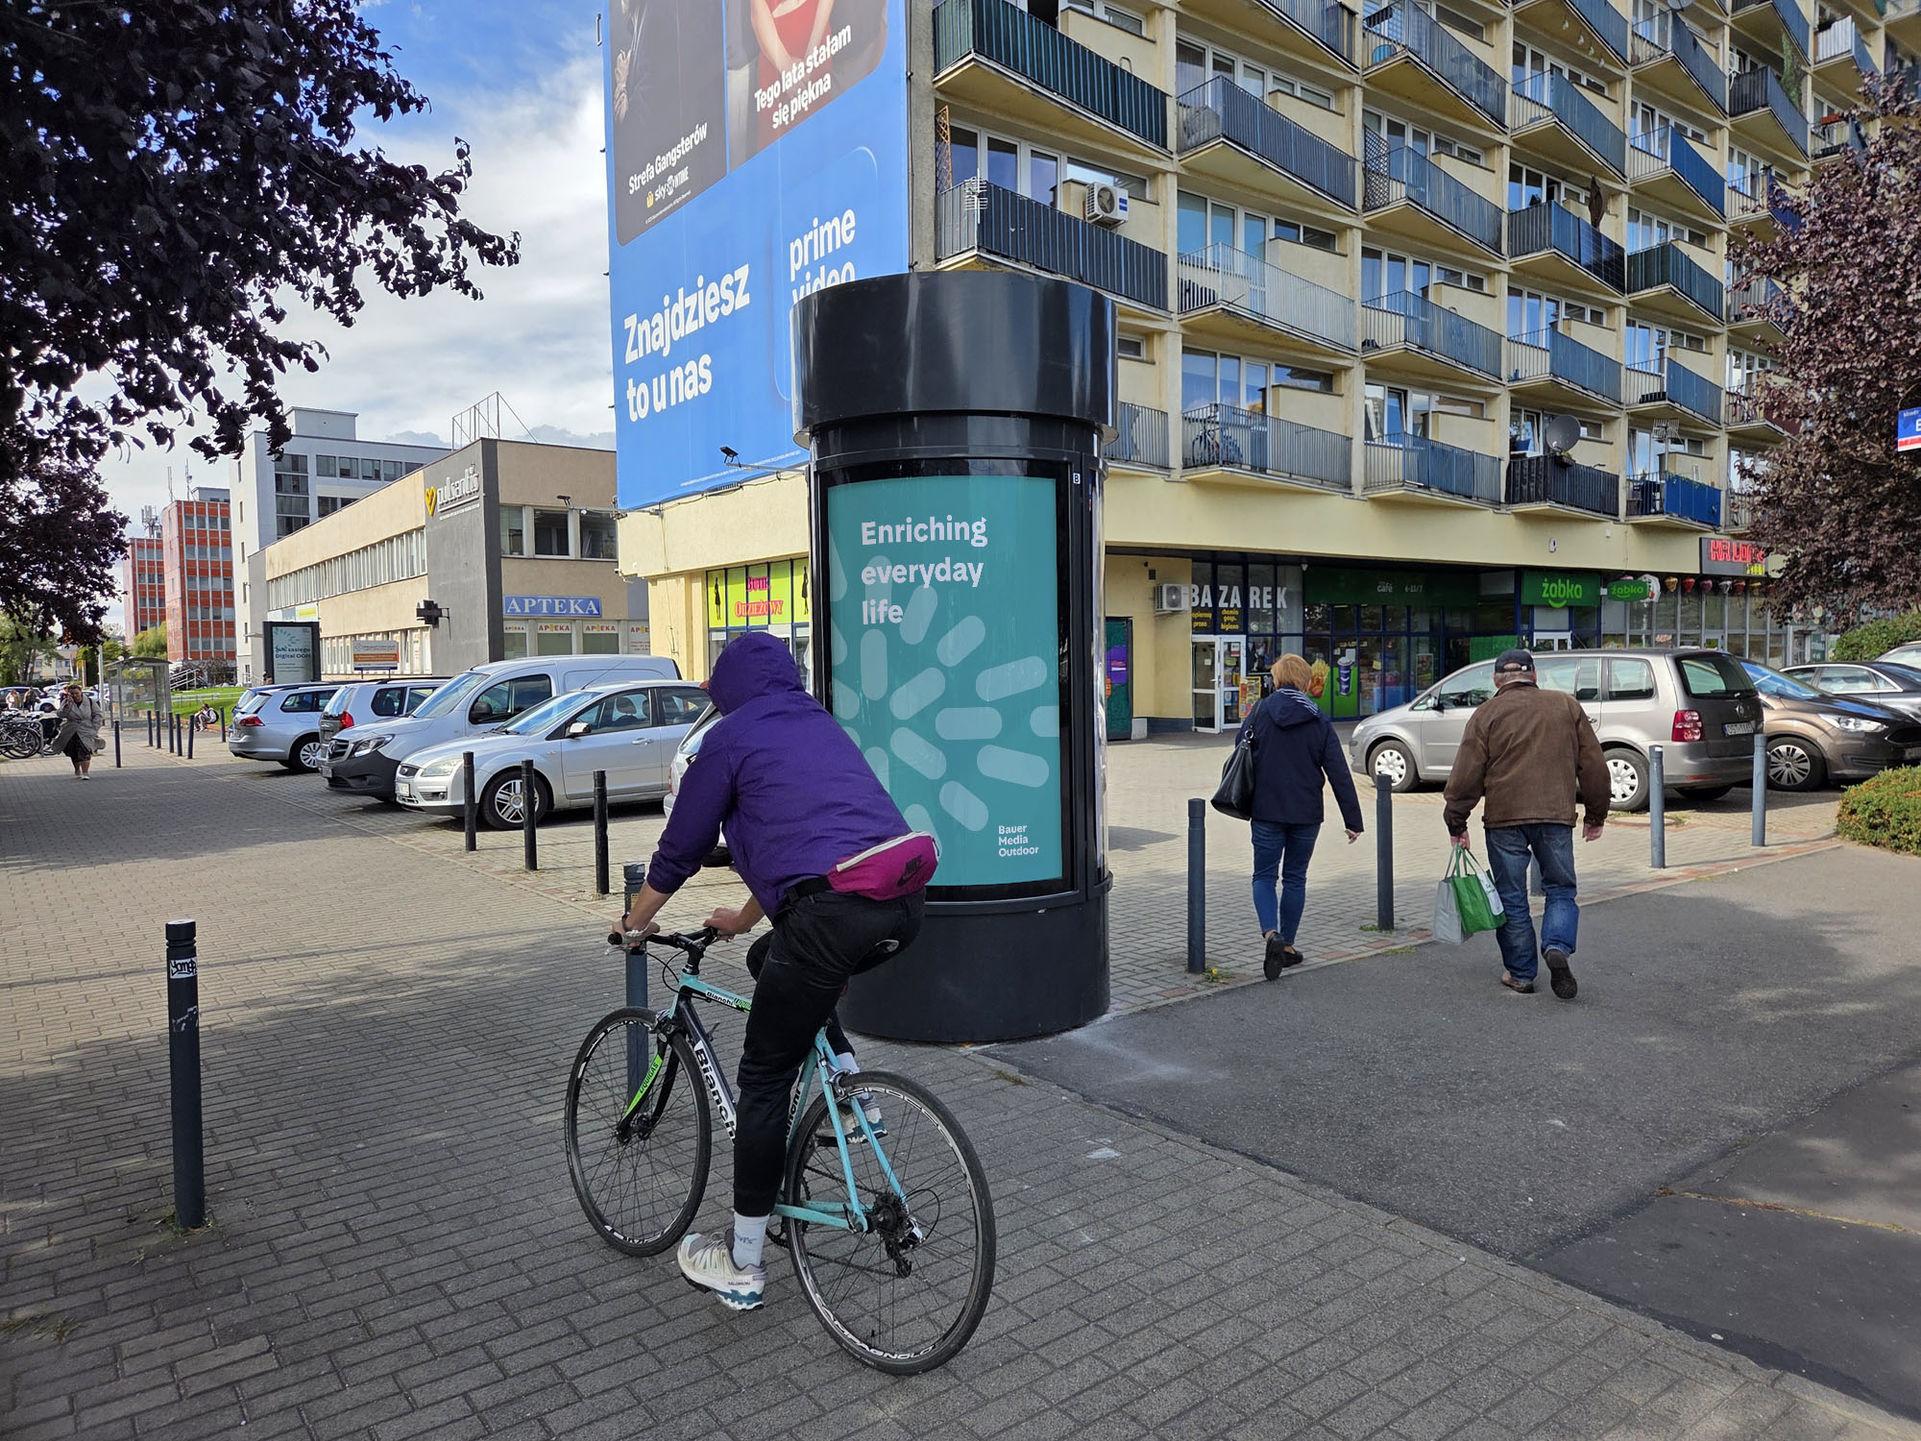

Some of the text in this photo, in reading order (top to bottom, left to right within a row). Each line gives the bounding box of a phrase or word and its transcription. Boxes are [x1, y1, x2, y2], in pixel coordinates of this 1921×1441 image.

[754, 24, 852, 112] Tego lata stałam
[772, 73, 832, 129] się piękna
[628, 122, 708, 195] Strefa Gangsterów
[789, 208, 857, 283] prime
[623, 263, 751, 365] Znajdziesz
[626, 353, 713, 423] to u nas
[861, 514, 989, 548] Enriching
[861, 556, 984, 589] everyday
[1541, 578, 1583, 599] żabka
[507, 598, 600, 615] APTEKA
[862, 599, 904, 625] life
[538, 624, 570, 632] APTEKA
[585, 624, 616, 632] APTEKA
[630, 625, 650, 634] APTE
[998, 824, 1028, 835] Bauer
[998, 834, 1029, 846] Media
[998, 846, 1040, 857] Outdoor
[695, 1048, 738, 1139] Bianch
